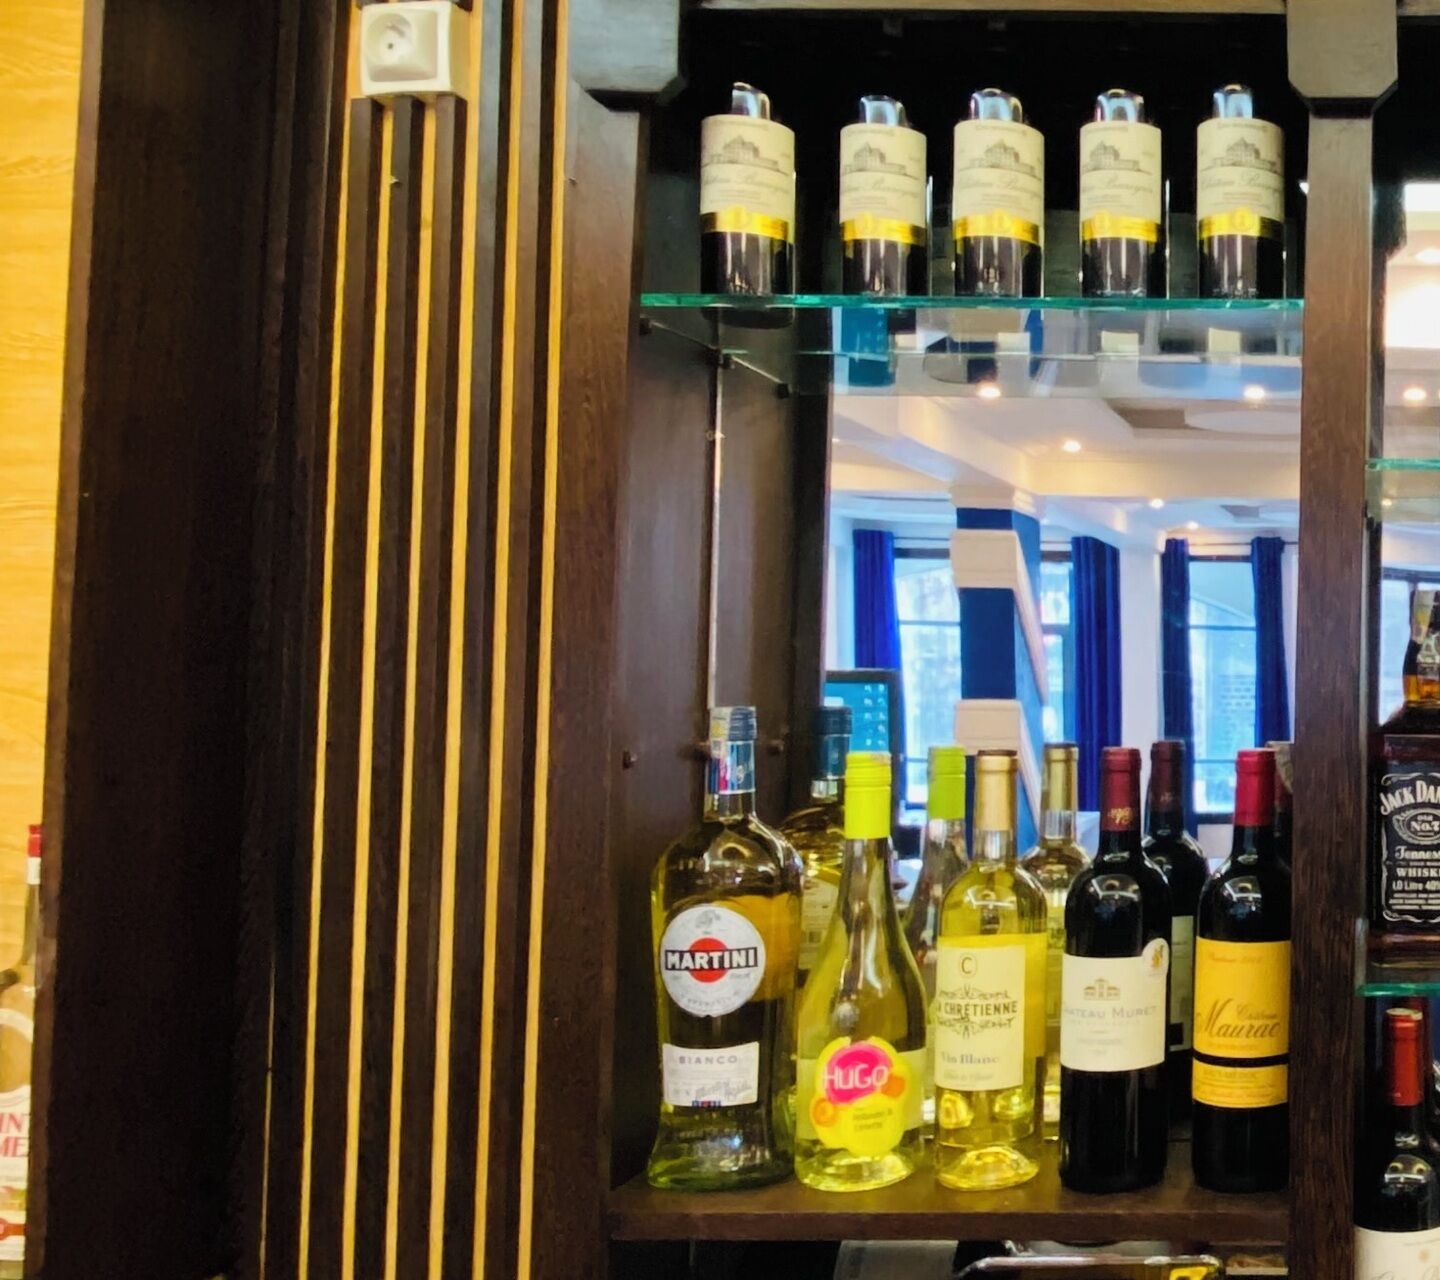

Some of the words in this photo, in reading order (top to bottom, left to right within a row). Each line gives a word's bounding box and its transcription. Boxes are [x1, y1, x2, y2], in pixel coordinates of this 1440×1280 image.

[1380, 786, 1415, 815] JACK
[666, 949, 756, 970] MARTINI
[678, 1055, 738, 1065] BIANCO
[823, 1063, 889, 1091] HUGO
